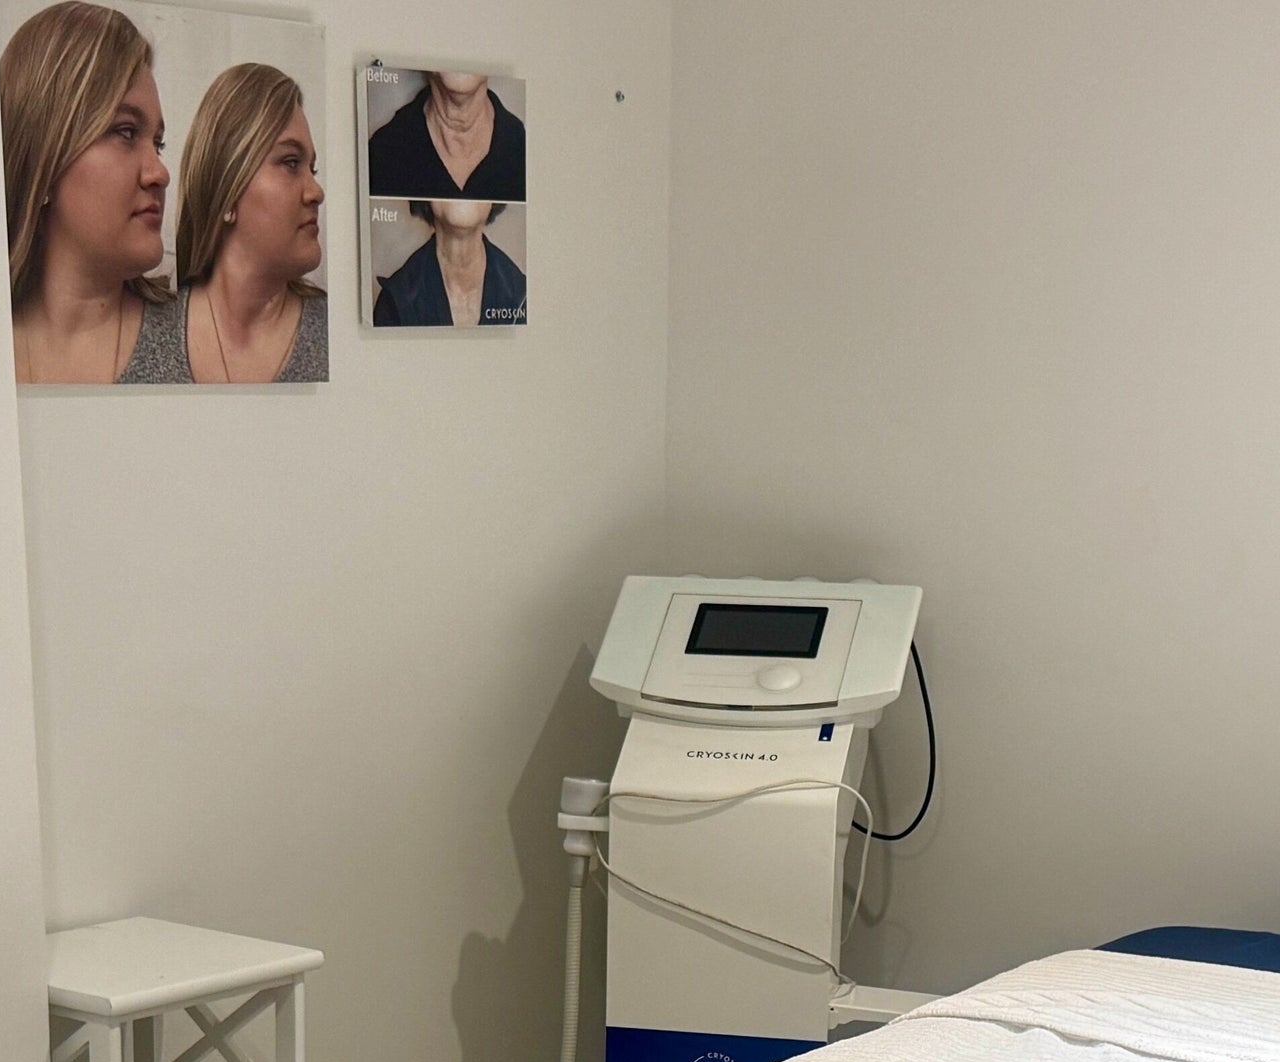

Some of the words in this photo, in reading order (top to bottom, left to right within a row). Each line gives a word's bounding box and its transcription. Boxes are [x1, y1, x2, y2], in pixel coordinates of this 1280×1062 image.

[367, 68, 399, 85] Before
[372, 207, 398, 223] After
[758, 754, 778, 762] 4.0
